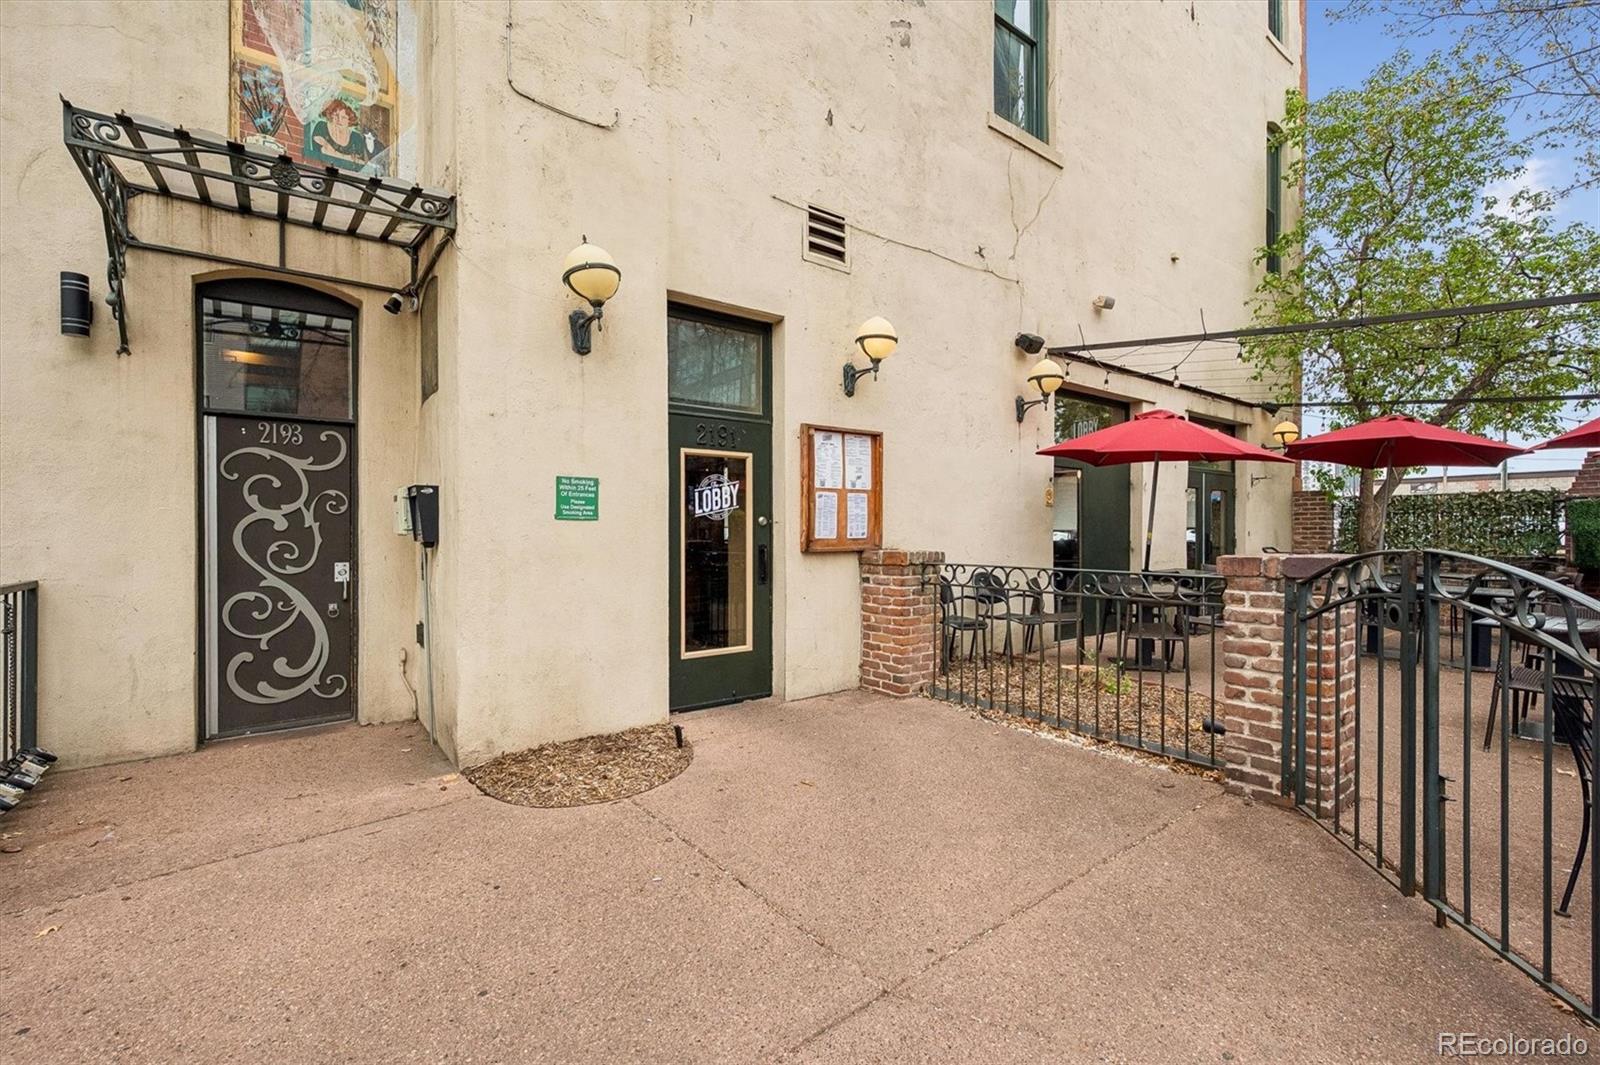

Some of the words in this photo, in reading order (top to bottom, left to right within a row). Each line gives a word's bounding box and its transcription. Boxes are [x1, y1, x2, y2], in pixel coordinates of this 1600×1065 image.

[258, 421, 303, 445] 2193
[696, 423, 737, 448] 2191
[571, 478, 594, 486] Smoking
[695, 483, 740, 514] LOBBY
